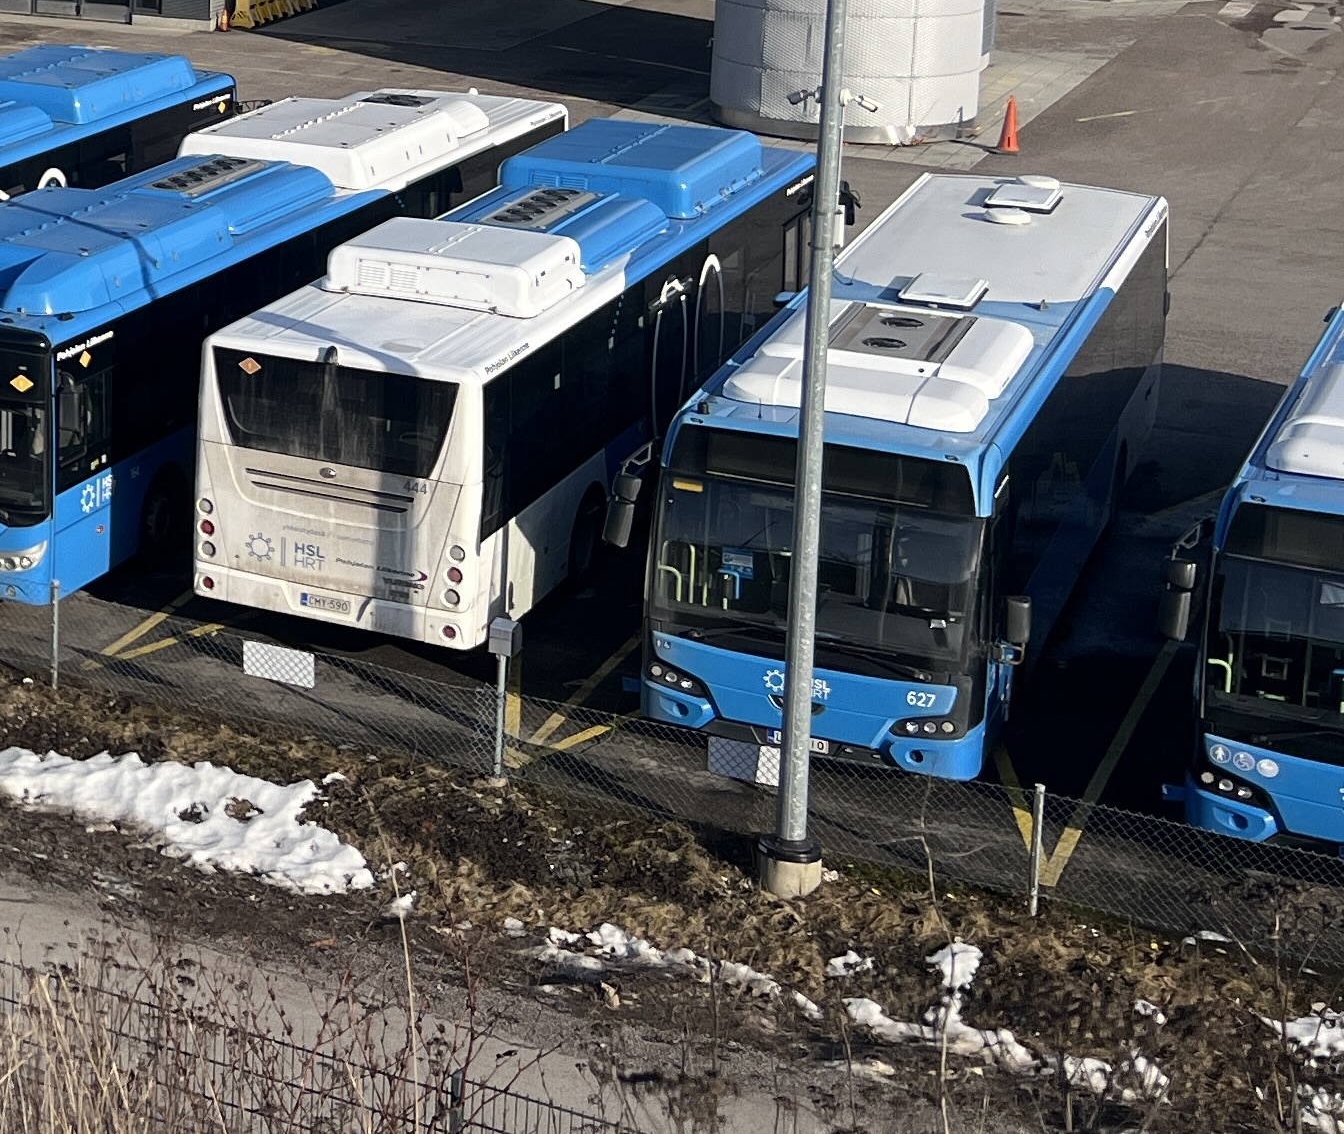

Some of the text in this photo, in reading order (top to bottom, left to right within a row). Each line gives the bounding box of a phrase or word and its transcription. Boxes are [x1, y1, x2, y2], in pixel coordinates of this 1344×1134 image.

[403, 480, 428, 495] 444
[294, 541, 325, 559] HSL
[294, 556, 325, 572] HRT
[308, 595, 349, 612] CMY-590
[906, 690, 937, 708] 627
